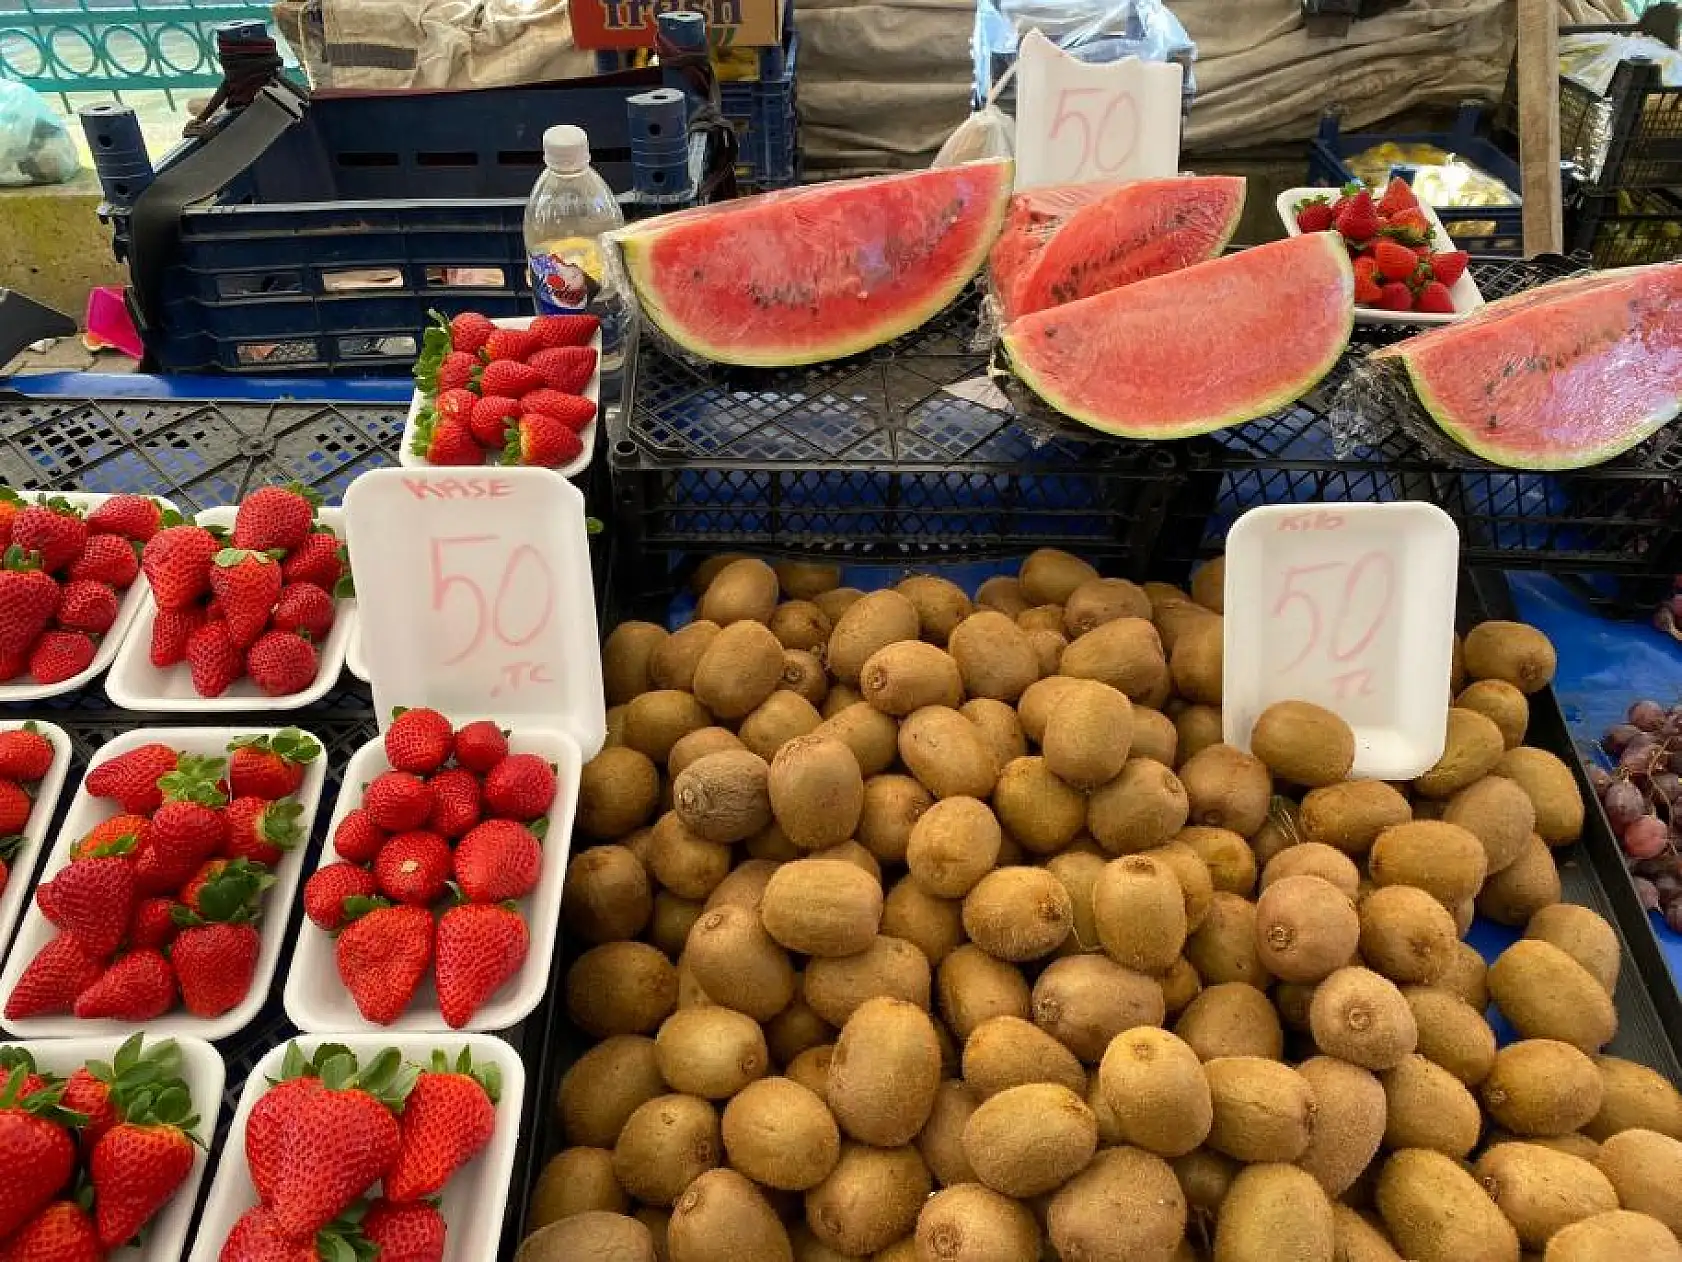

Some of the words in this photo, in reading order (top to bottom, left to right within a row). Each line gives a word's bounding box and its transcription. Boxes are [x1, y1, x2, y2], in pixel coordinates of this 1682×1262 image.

[1048, 86, 1142, 179] 50
[428, 533, 556, 667] 50
[1268, 550, 1395, 675] 50
